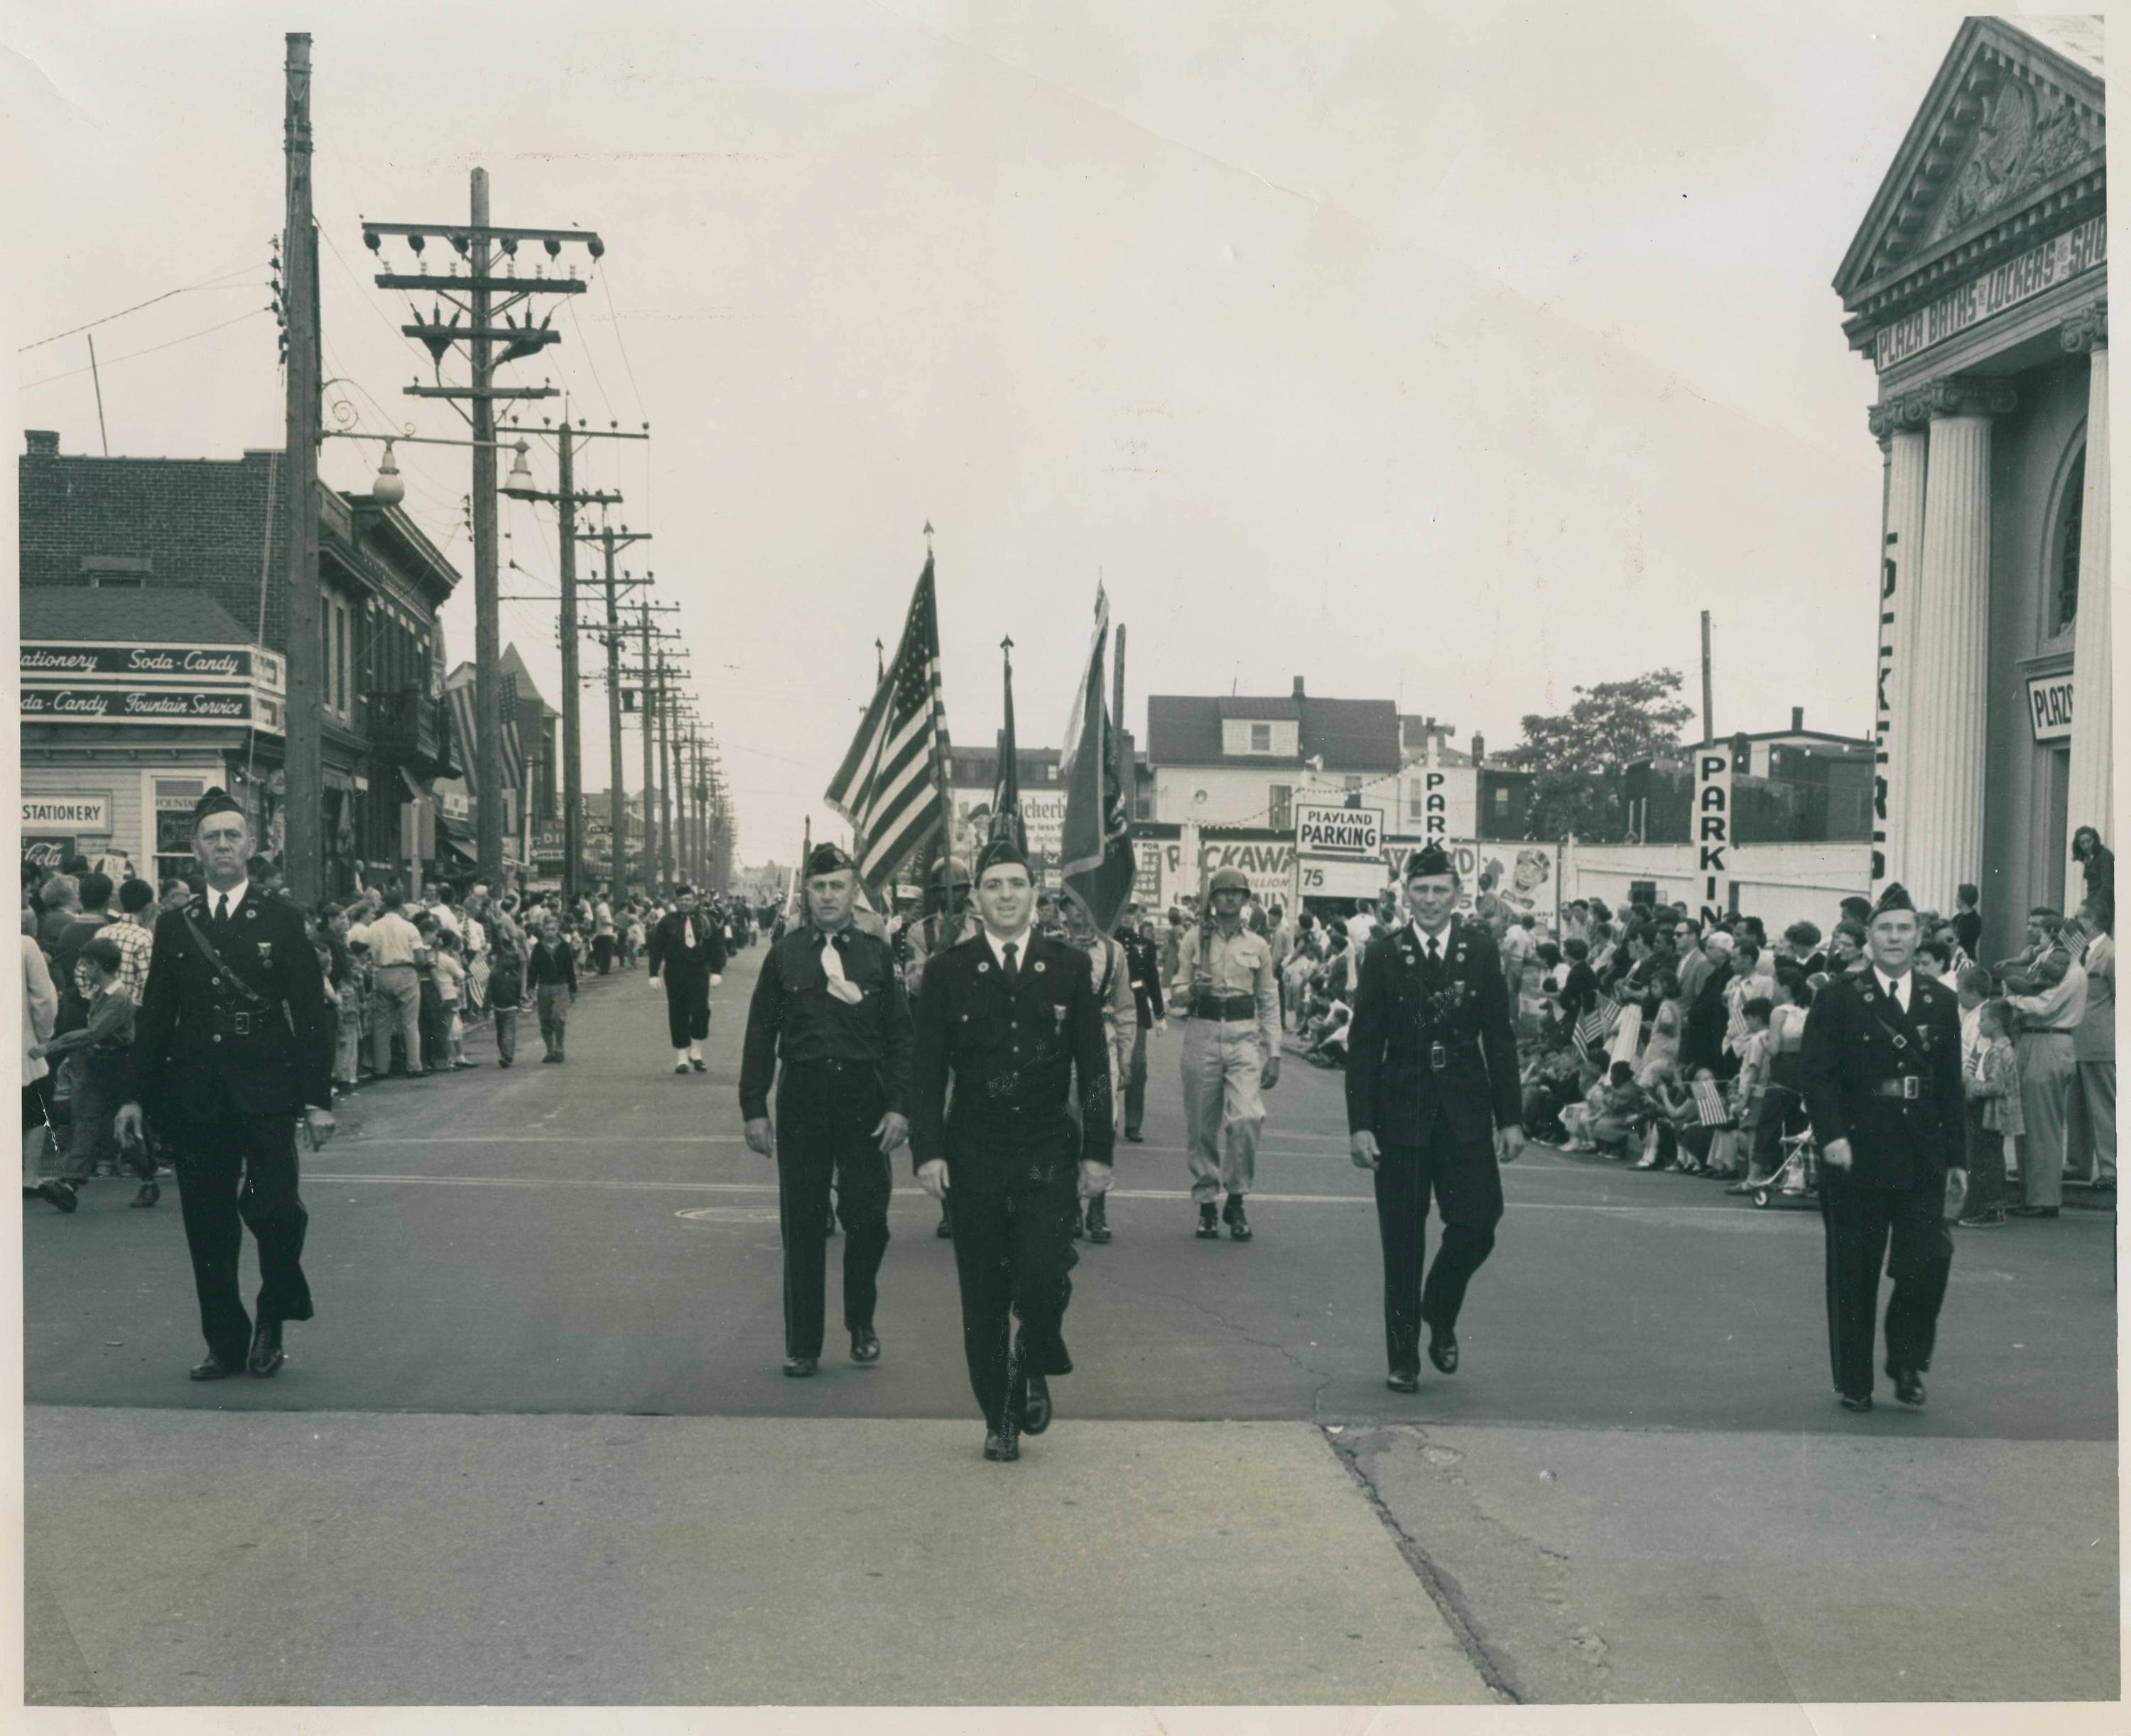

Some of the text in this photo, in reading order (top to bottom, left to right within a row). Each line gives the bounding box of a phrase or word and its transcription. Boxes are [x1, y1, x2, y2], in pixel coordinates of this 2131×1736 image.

[1879, 311, 1923, 368] PLAZA
[1929, 285, 1977, 343] BATHS
[1987, 240, 2056, 313] LOCKERS
[20, 651, 97, 672] ationery
[125, 693, 187, 713] Fountain
[190, 694, 242, 715] Service
[23, 805, 101, 820] STATIONERY
[1308, 810, 1372, 825] PLAYLAND
[1301, 825, 1376, 847] PARKING
[1303, 869, 1323, 886] 75
